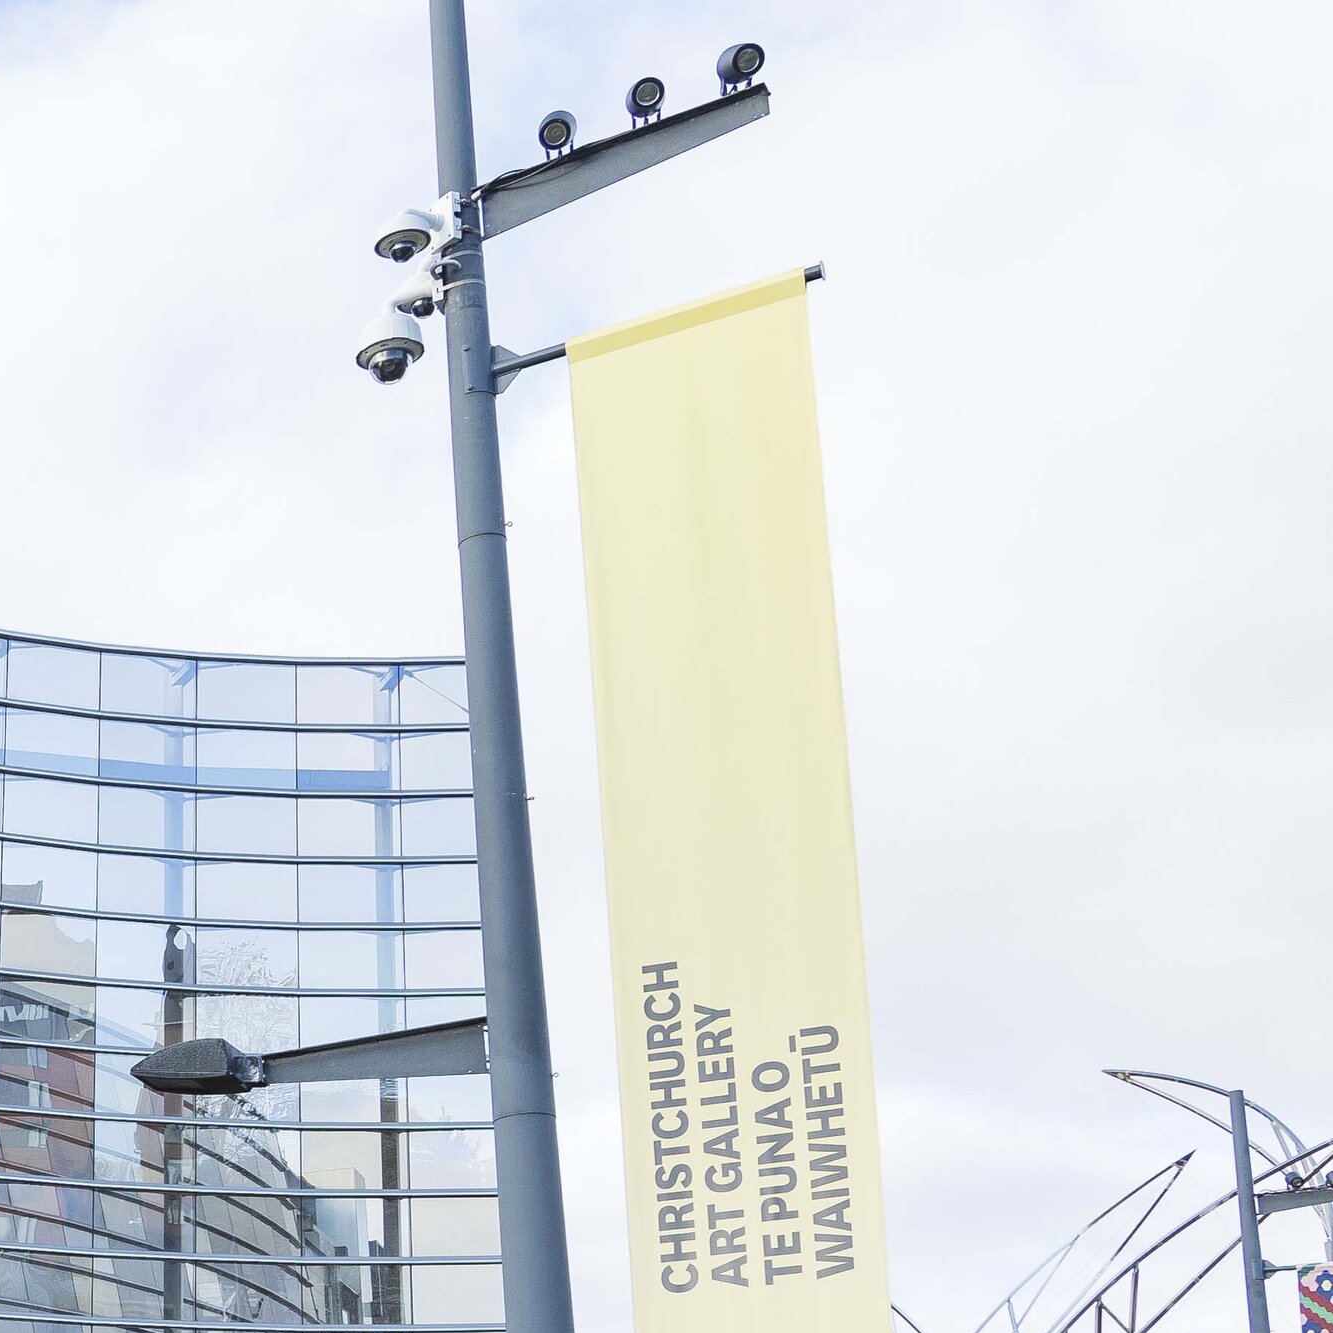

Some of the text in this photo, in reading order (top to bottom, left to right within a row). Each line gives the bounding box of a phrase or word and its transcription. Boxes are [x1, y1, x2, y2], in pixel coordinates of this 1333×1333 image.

[641, 960, 699, 1294] CHRISTCHURCH
[693, 1003, 749, 1288] ART GALLERY
[762, 1231, 803, 1286] TE
[789, 1024, 855, 1280] WAIWHETŪ
